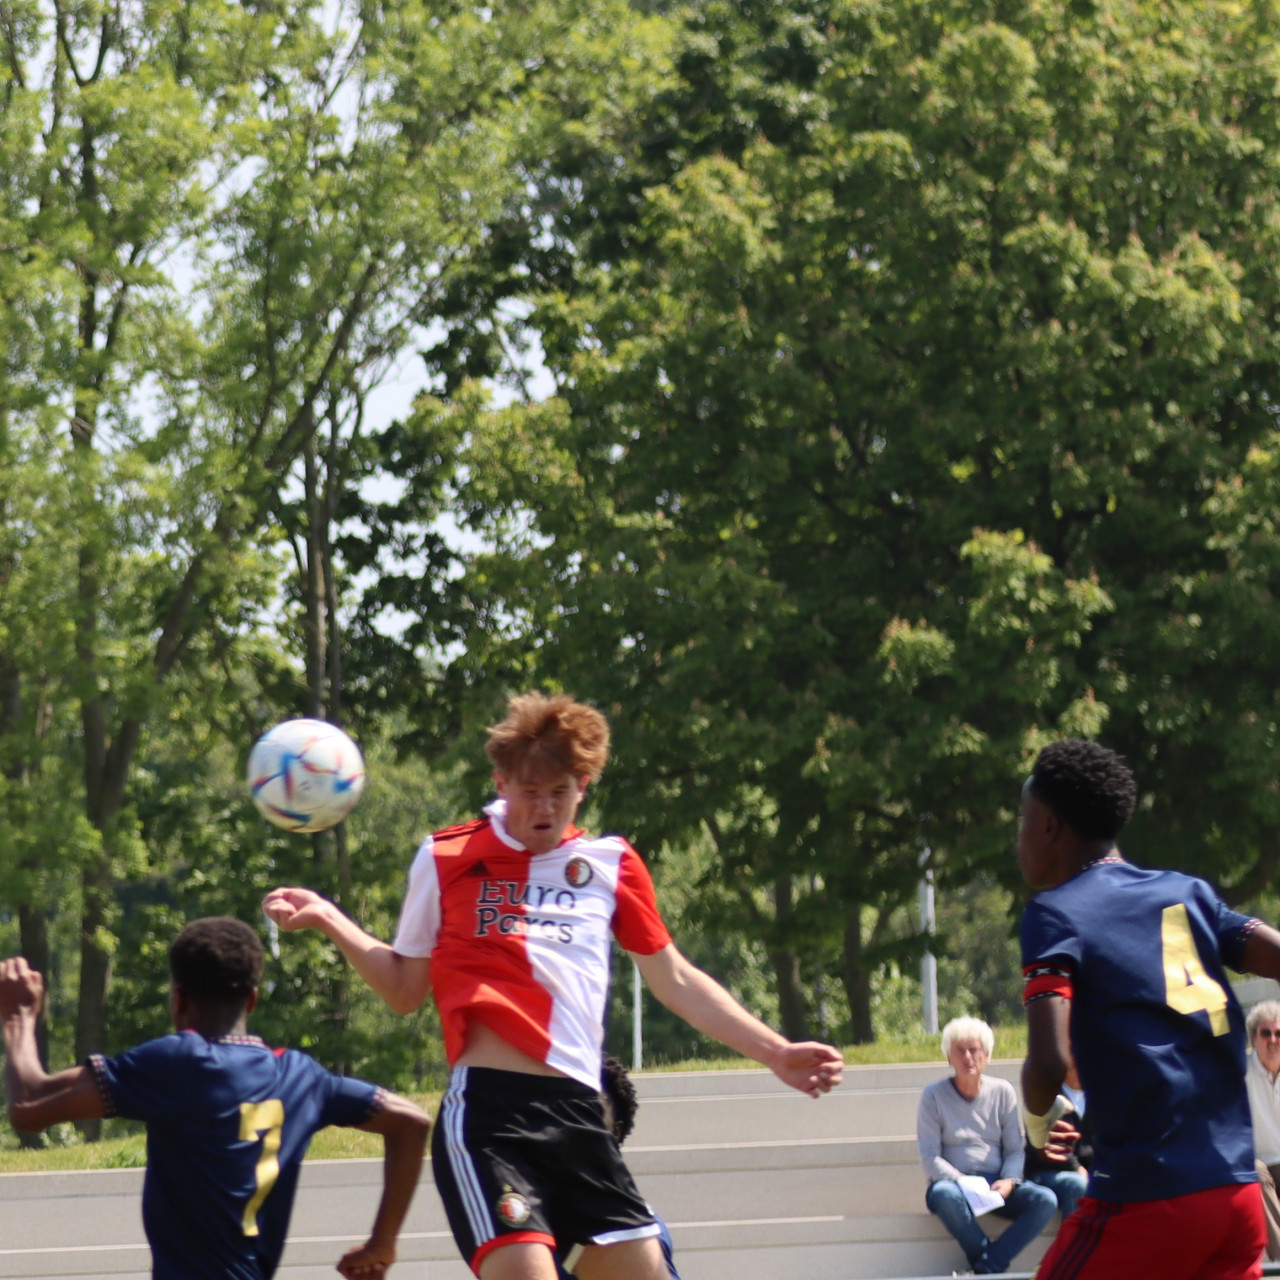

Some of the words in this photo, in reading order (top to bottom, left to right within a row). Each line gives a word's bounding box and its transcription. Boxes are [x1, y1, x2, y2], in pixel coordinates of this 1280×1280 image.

[476, 880, 577, 911] Euro
[1160, 903, 1231, 1037] 4
[238, 1098, 285, 1236] 7
